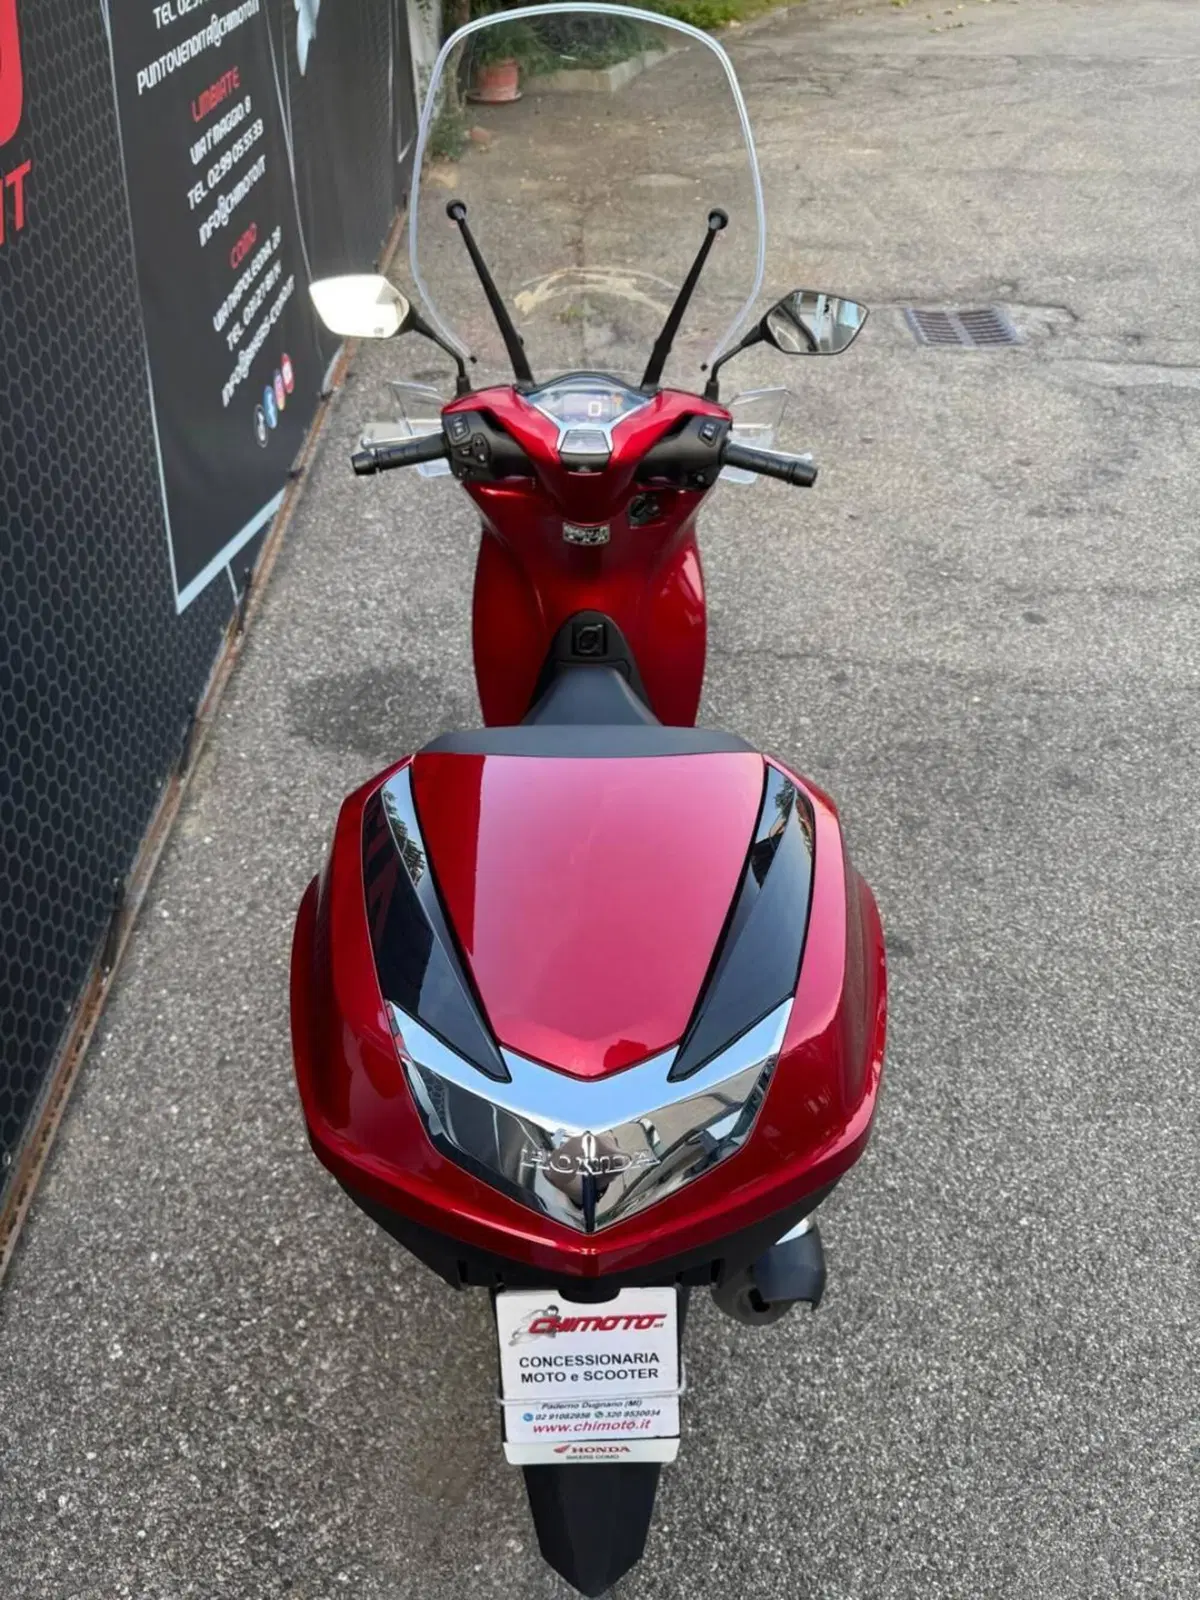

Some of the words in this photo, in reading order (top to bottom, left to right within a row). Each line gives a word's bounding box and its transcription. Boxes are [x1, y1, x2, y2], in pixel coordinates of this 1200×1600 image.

[521, 1149, 661, 1176] HONDA
[528, 1313, 667, 1334] CHIMOTO
[519, 1352, 660, 1368] CONCESSIONARIA
[521, 1371, 566, 1383] MOTO
[571, 1374, 579, 1382] e
[584, 1368, 659, 1381] SCOOTER
[541, 1401, 580, 1411] Paderno
[582, 1400, 623, 1410] Dugnano
[533, 1418, 651, 1433] www.chimoto.it
